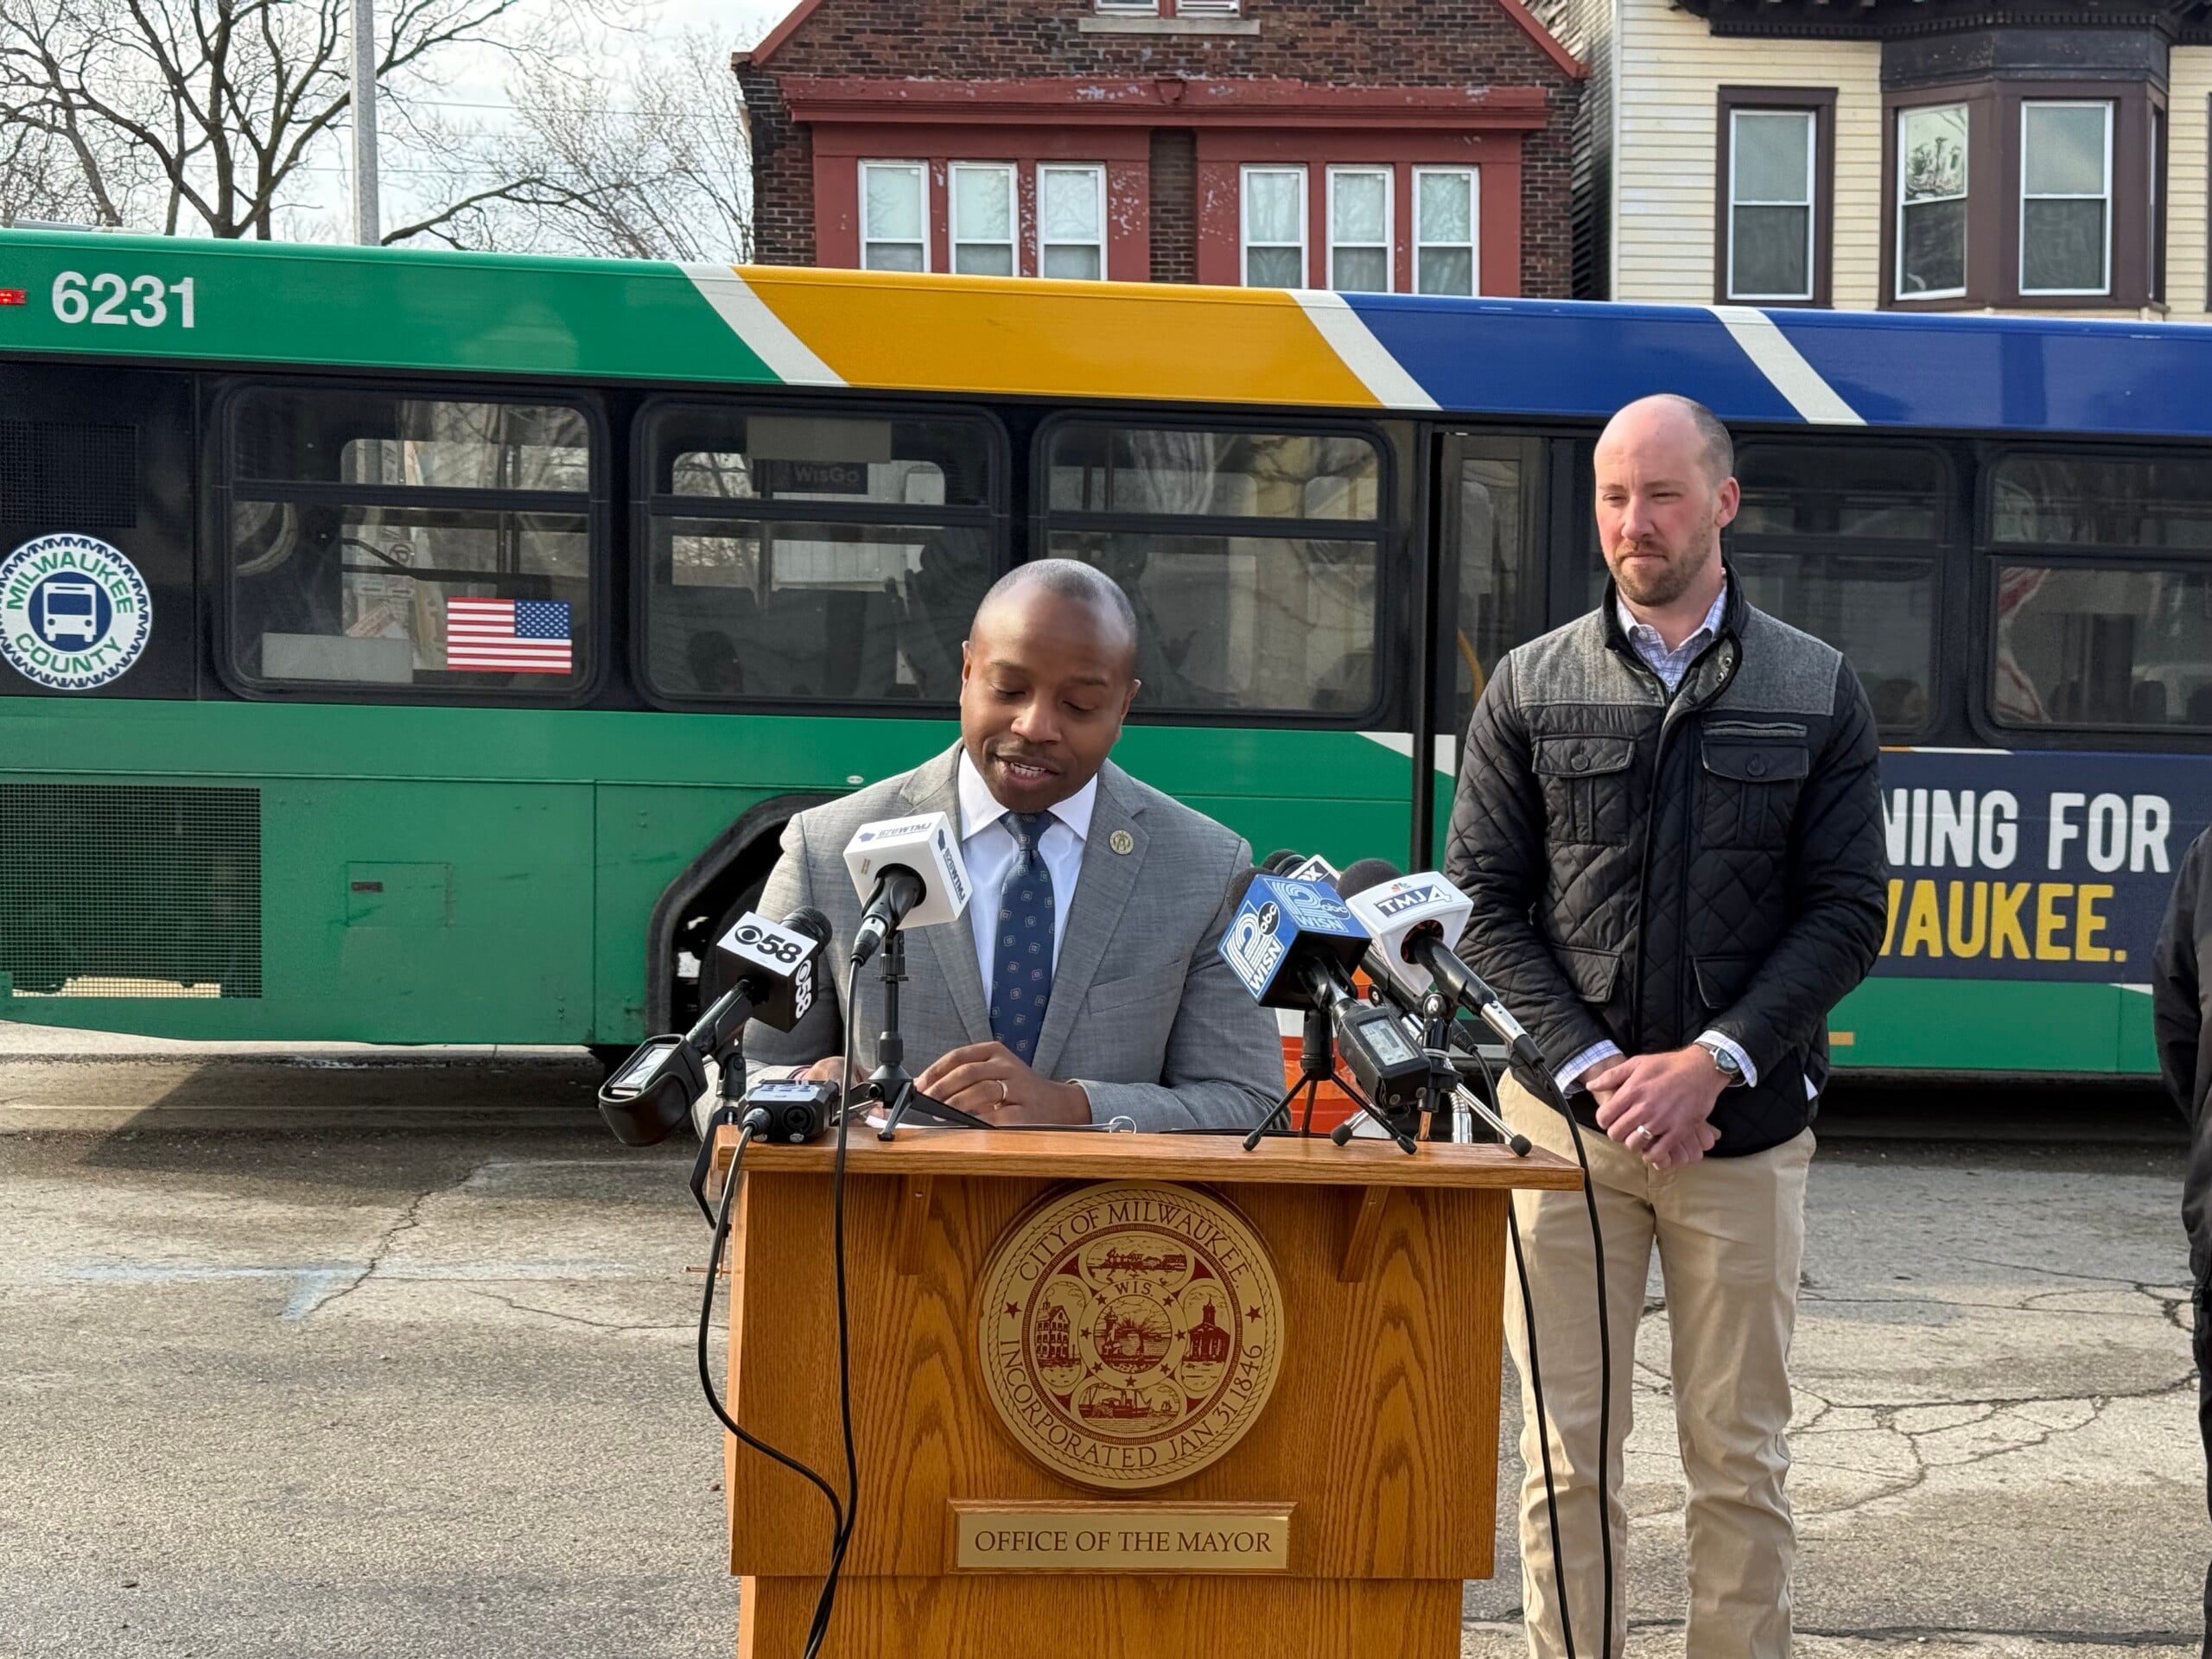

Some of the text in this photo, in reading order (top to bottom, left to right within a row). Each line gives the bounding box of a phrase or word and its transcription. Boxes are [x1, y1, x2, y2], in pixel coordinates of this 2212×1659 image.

[52, 270, 195, 328] 6231
[6, 551, 135, 613] MILWAUKEE
[15, 632, 123, 674] COUNTY
[2048, 791, 2171, 874] FOR
[1260, 904, 1278, 934] abc
[1295, 915, 1344, 931] WISN
[1249, 941, 1282, 991] WISN
[1020, 1227, 1068, 1281] CITY
[1071, 1208, 1099, 1235] OF
[1114, 1281, 1154, 1297] WIS.
[1000, 1339, 1263, 1469] INCORPORATED JAN. 31 1846
[974, 1530, 1273, 1554] OFFICE OF THE MAYOR
